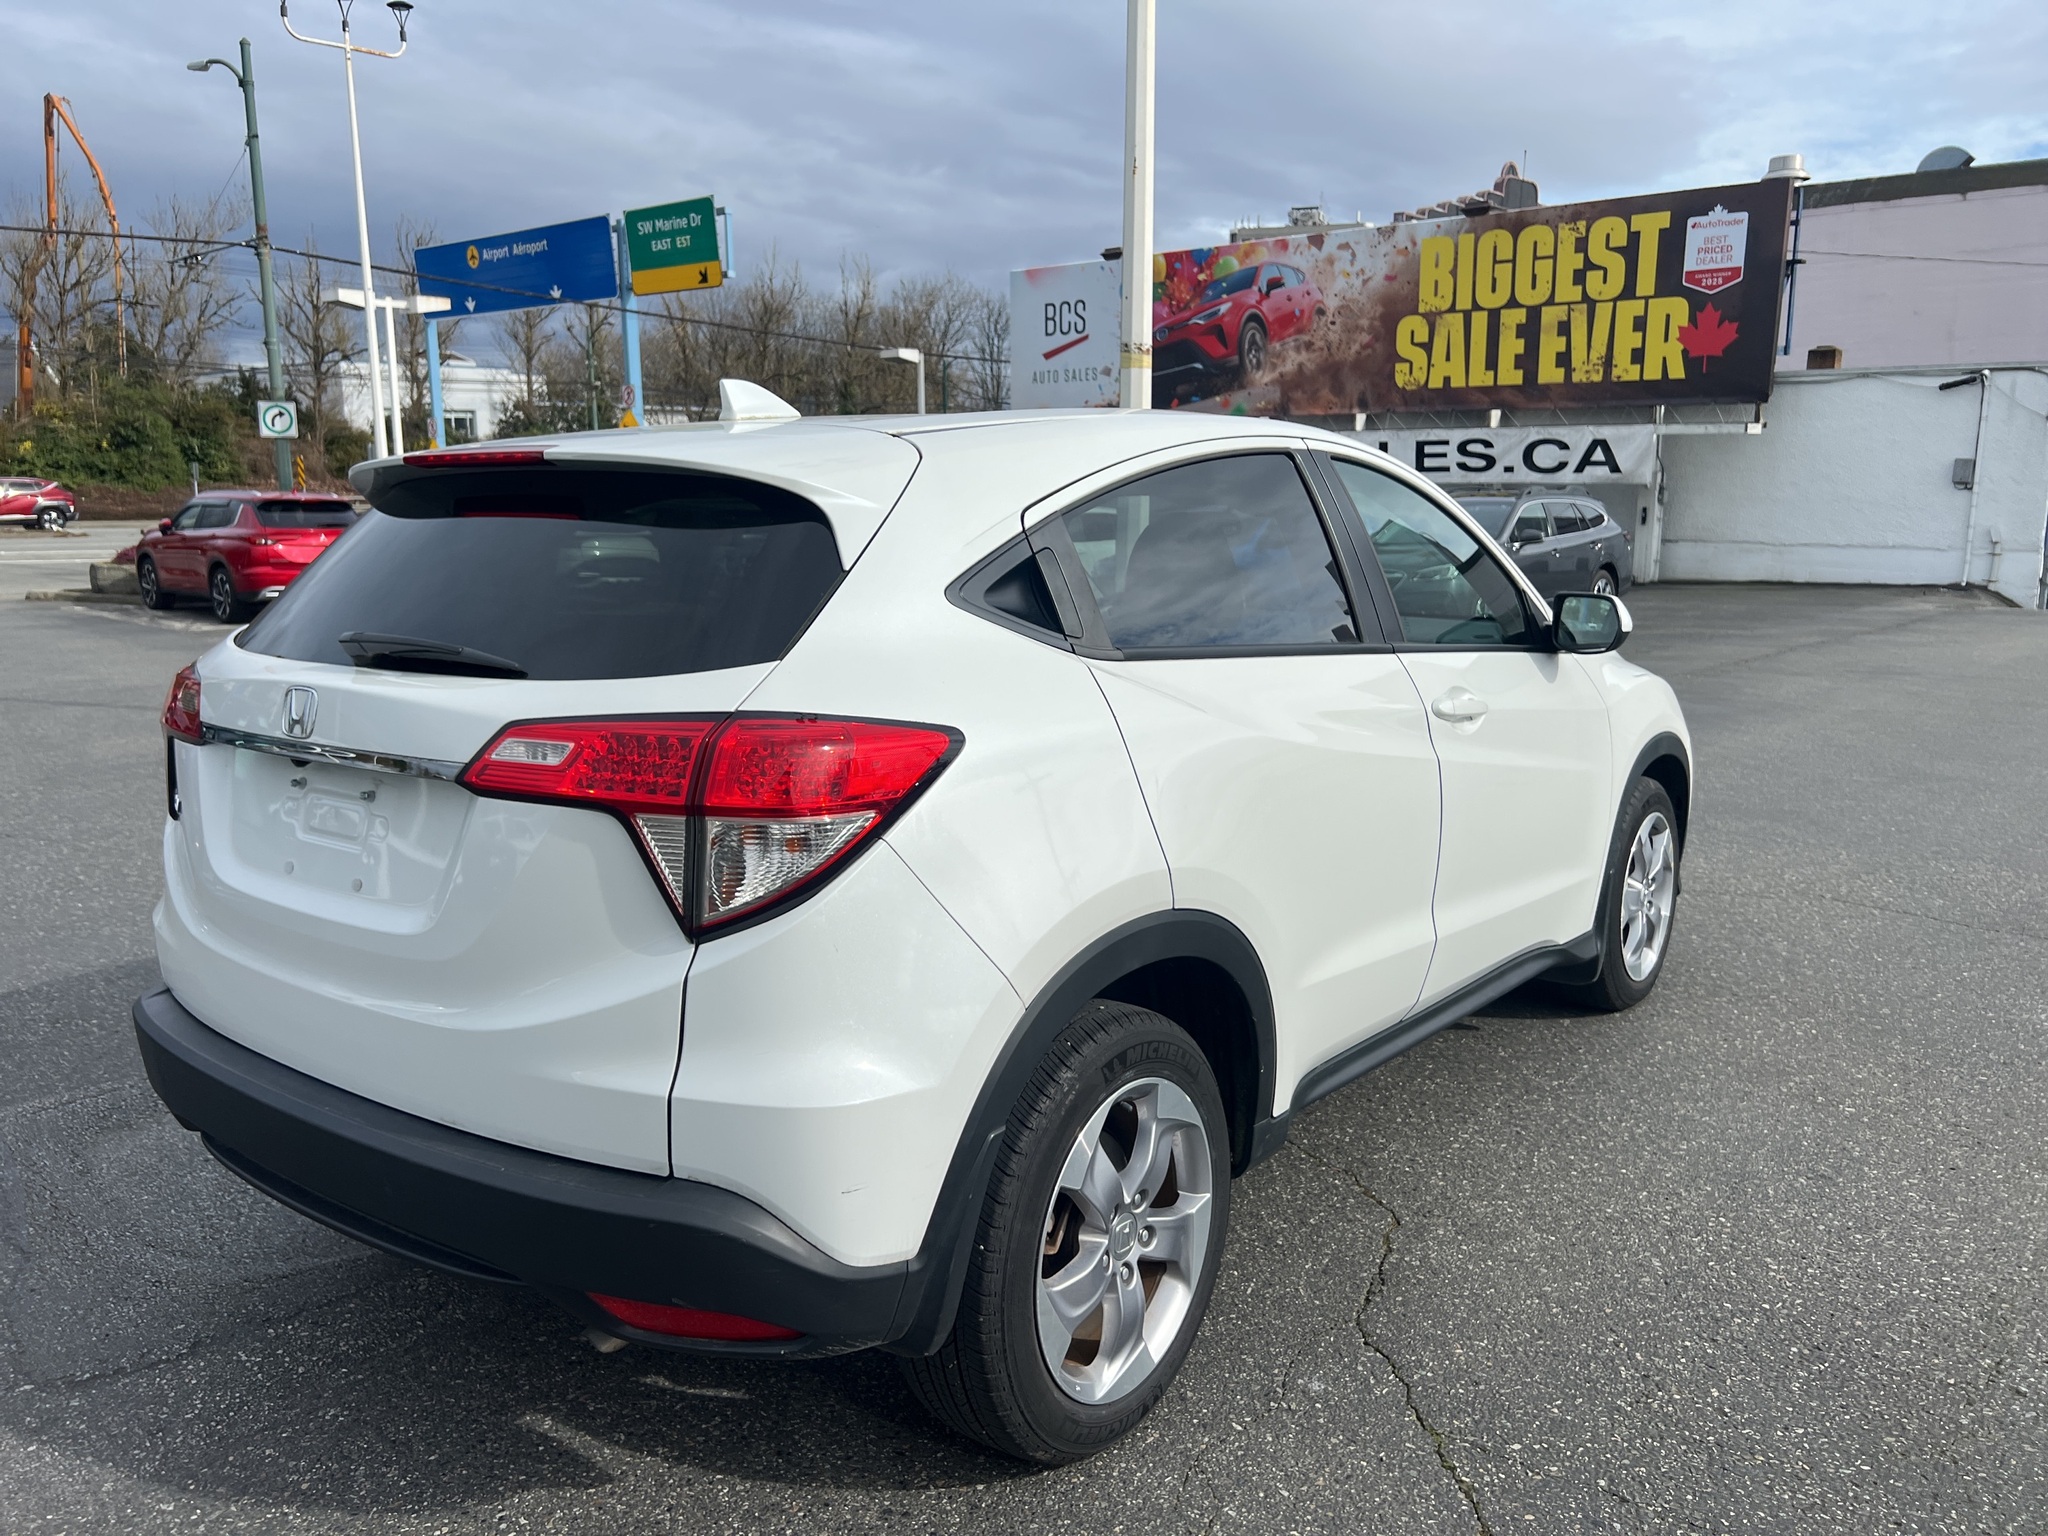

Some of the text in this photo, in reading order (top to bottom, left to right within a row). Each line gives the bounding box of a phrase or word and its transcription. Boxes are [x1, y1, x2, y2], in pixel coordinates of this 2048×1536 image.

[637, 213, 702, 235] SW Marine Dr
[1694, 218, 1745, 230] AutoTrader
[651, 235, 691, 252] EAST EST
[1703, 234, 1729, 246] BEST
[483, 238, 548, 262] Airport Aéroport
[1697, 244, 1733, 256] PRICED
[1418, 210, 1671, 314] BIGGEST
[1695, 254, 1733, 266] DEALER
[1044, 299, 1086, 337] BCS
[1394, 296, 1689, 391] SALE EVER
[1032, 367, 1098, 384] AUTO SALES
[1126, 1041, 1200, 1075] MICHELIN
